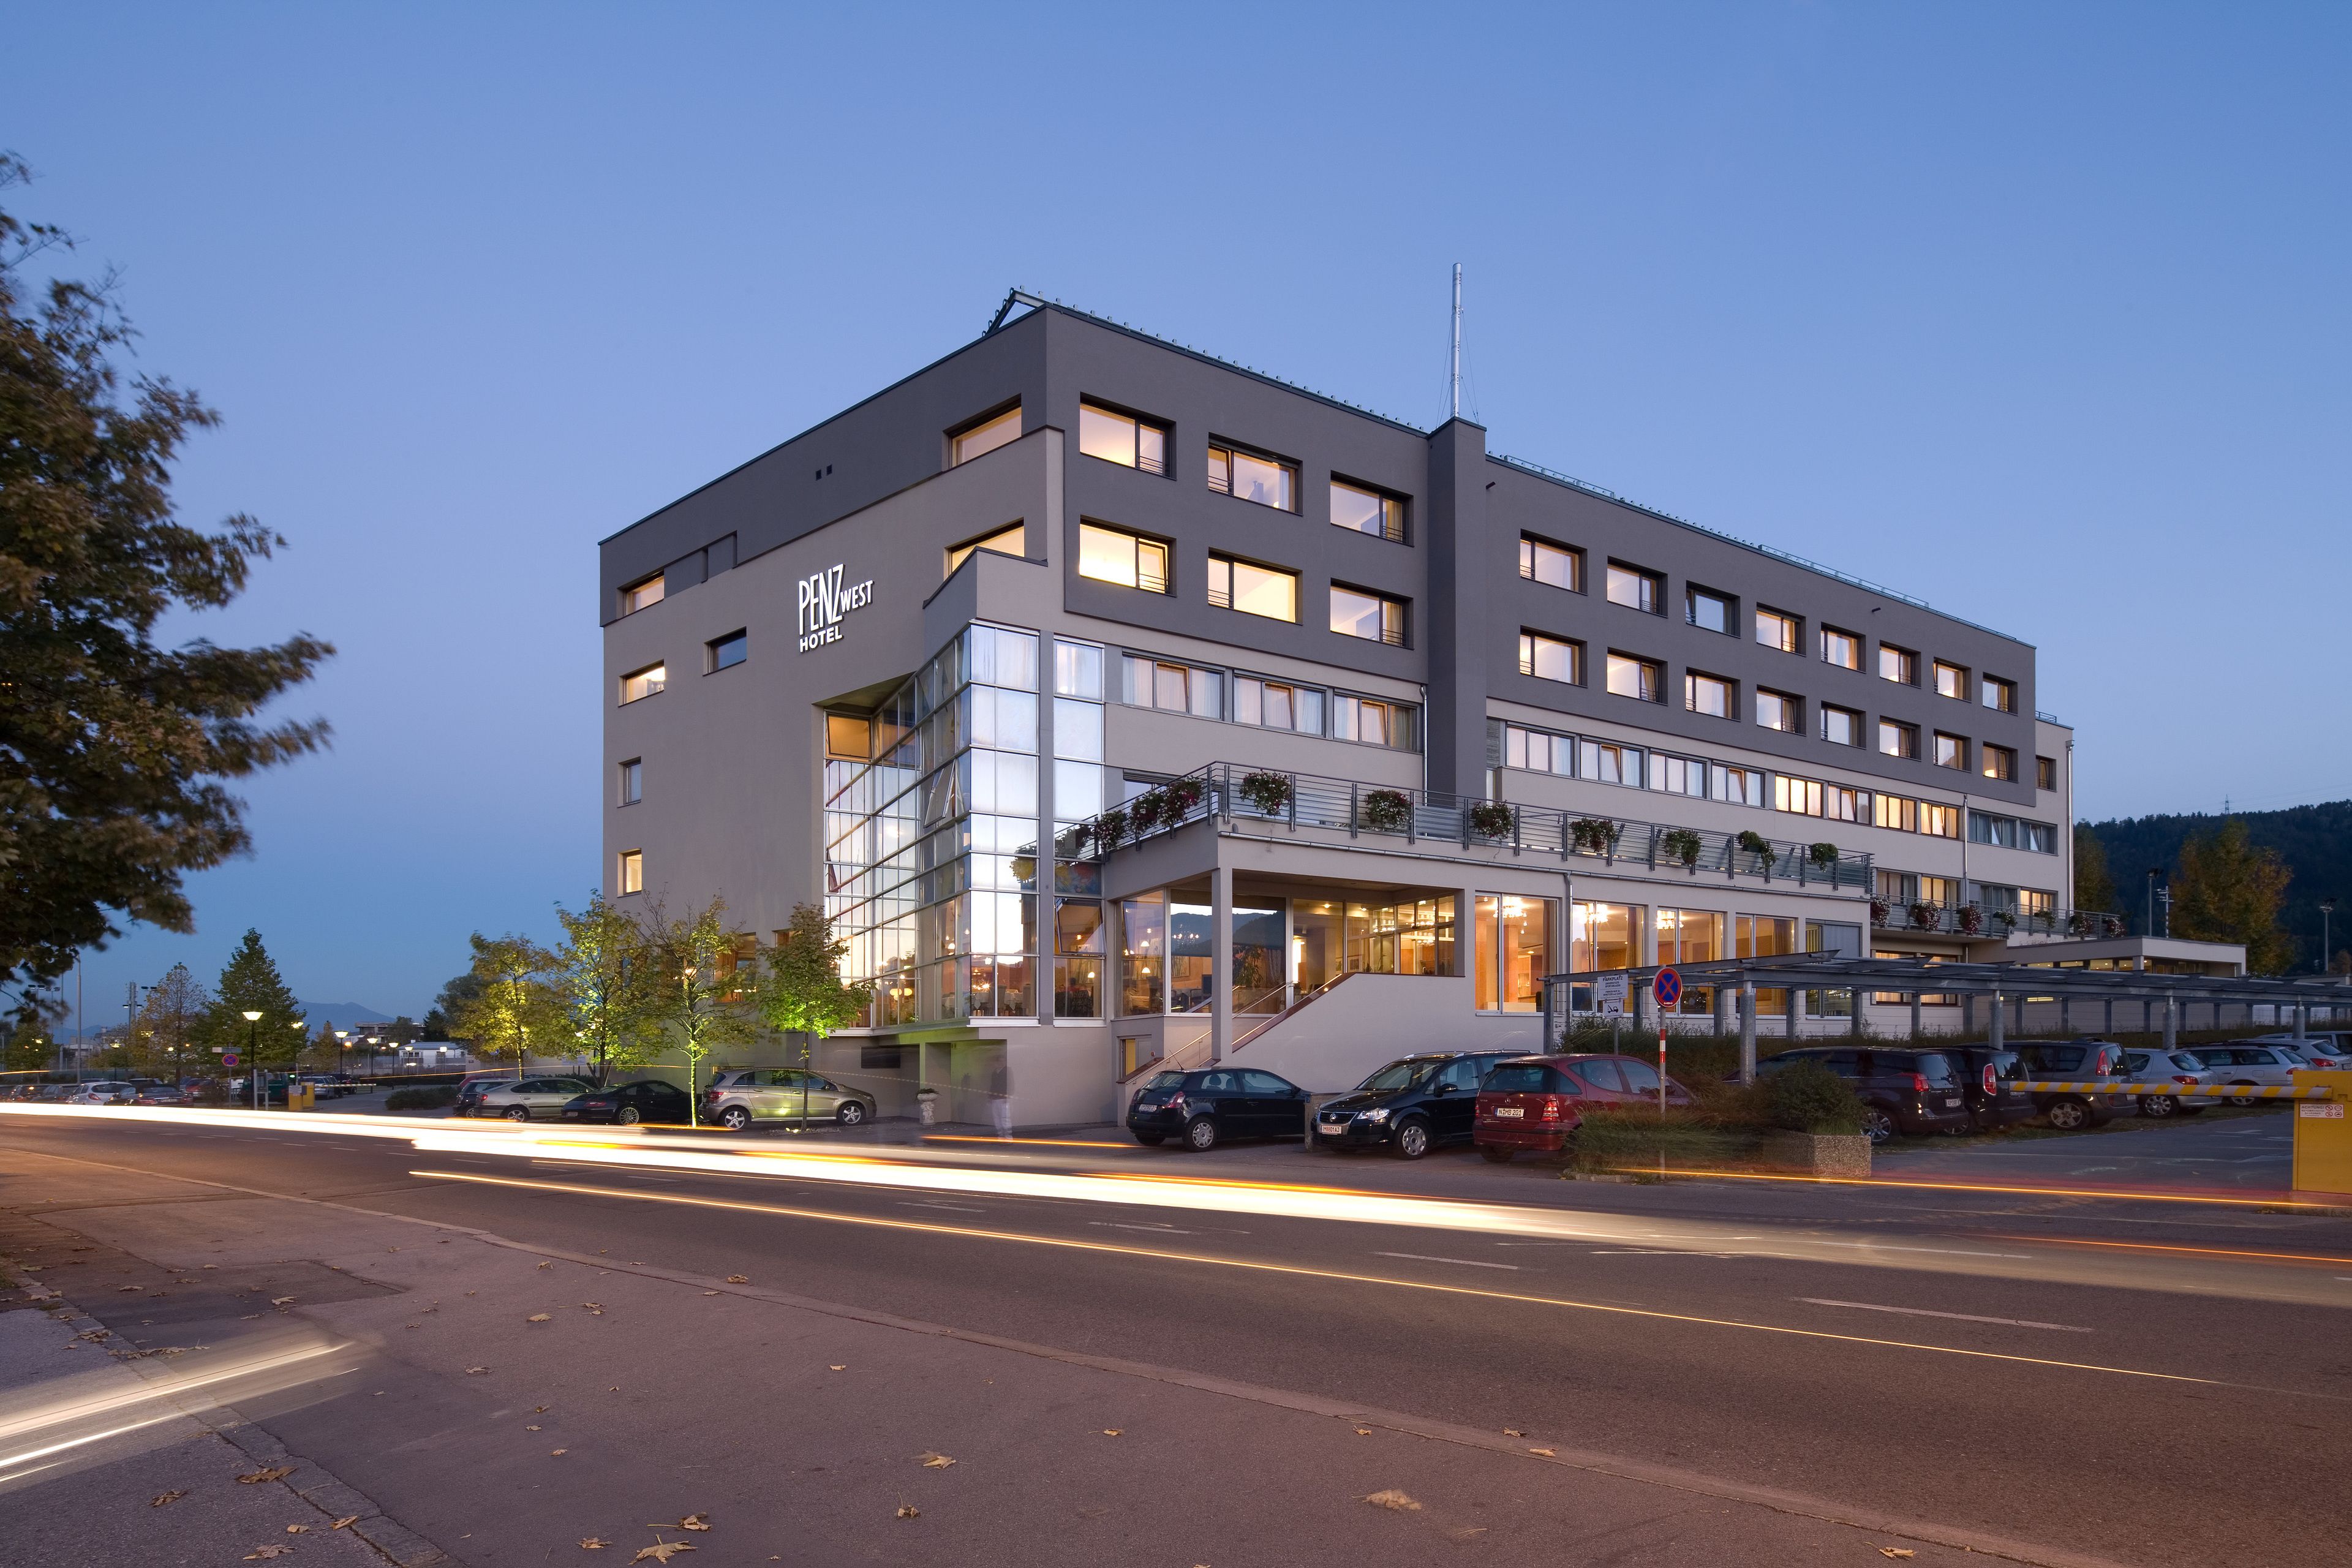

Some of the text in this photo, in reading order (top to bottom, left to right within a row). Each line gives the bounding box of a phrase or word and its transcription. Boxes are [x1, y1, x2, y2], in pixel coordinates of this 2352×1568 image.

[799, 564, 873, 635] PENZ WEST
[800, 625, 843, 652] HOTEL
